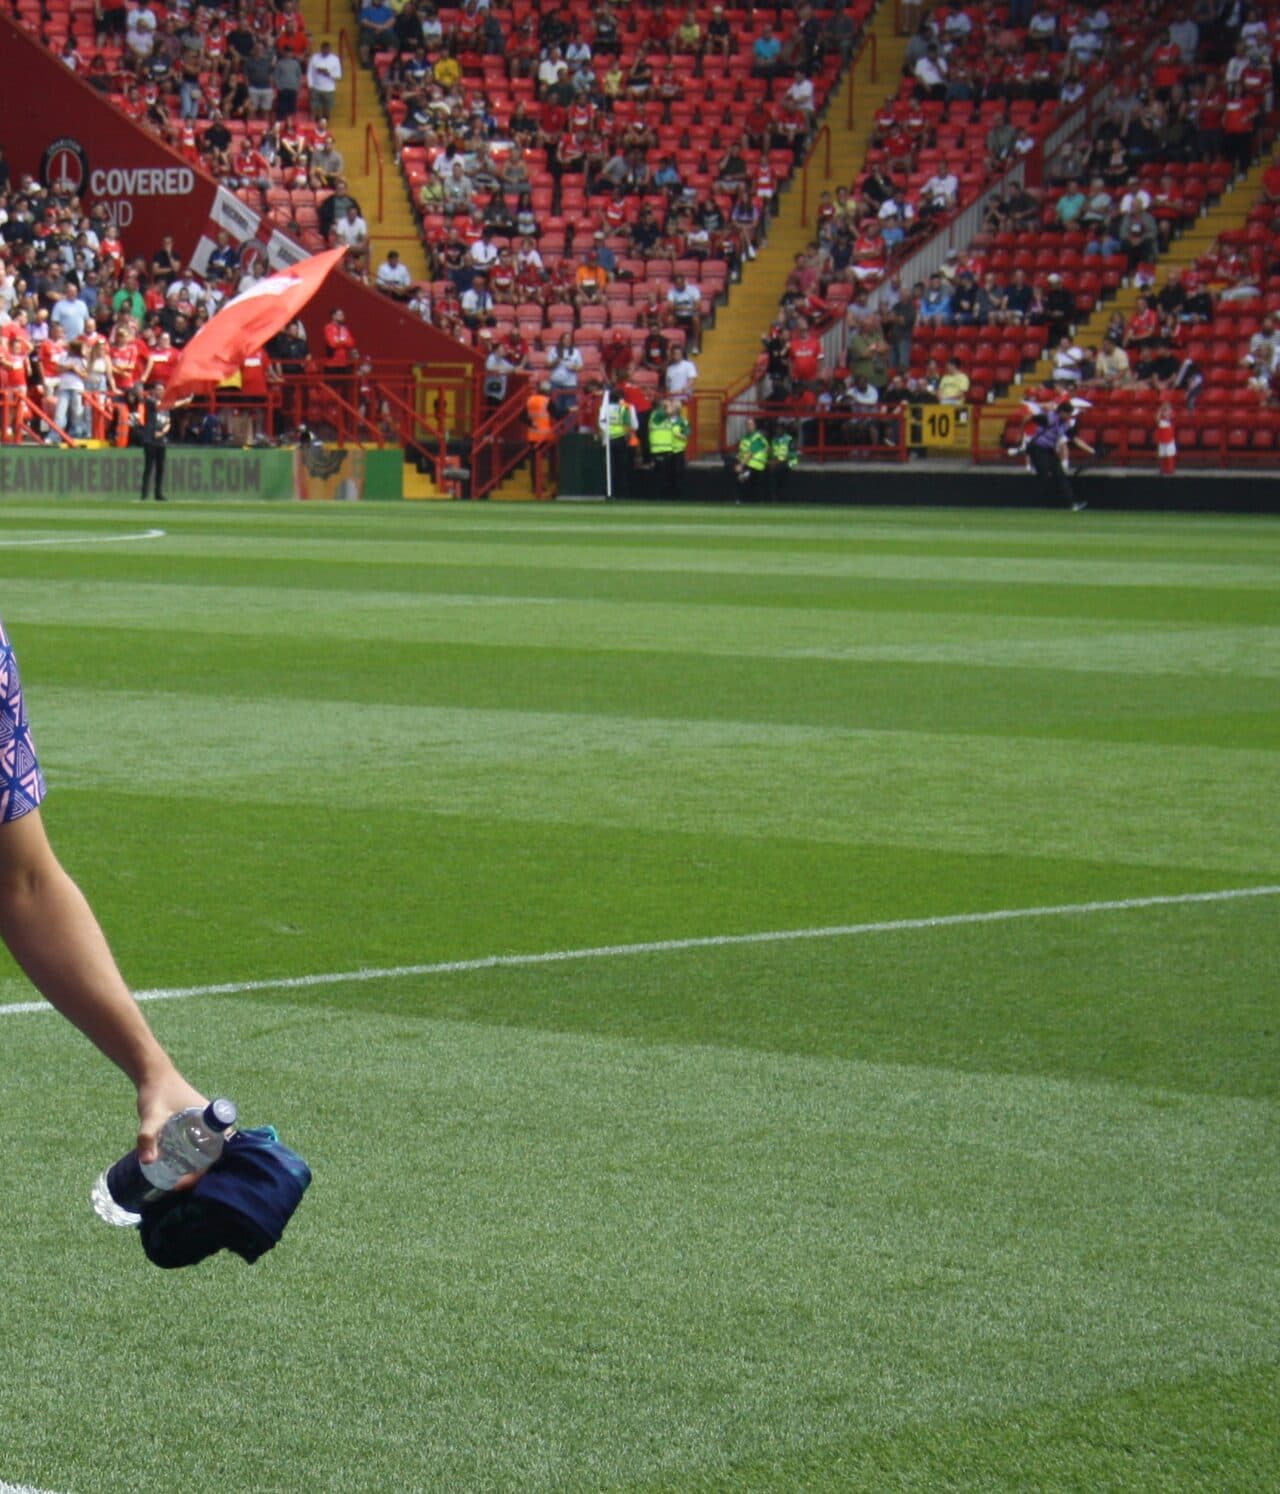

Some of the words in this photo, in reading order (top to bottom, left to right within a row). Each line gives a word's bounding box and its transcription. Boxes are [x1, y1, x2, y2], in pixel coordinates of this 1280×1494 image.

[90, 168, 195, 196] COVERED
[95, 200, 133, 227] ND
[928, 413, 950, 438] 10
